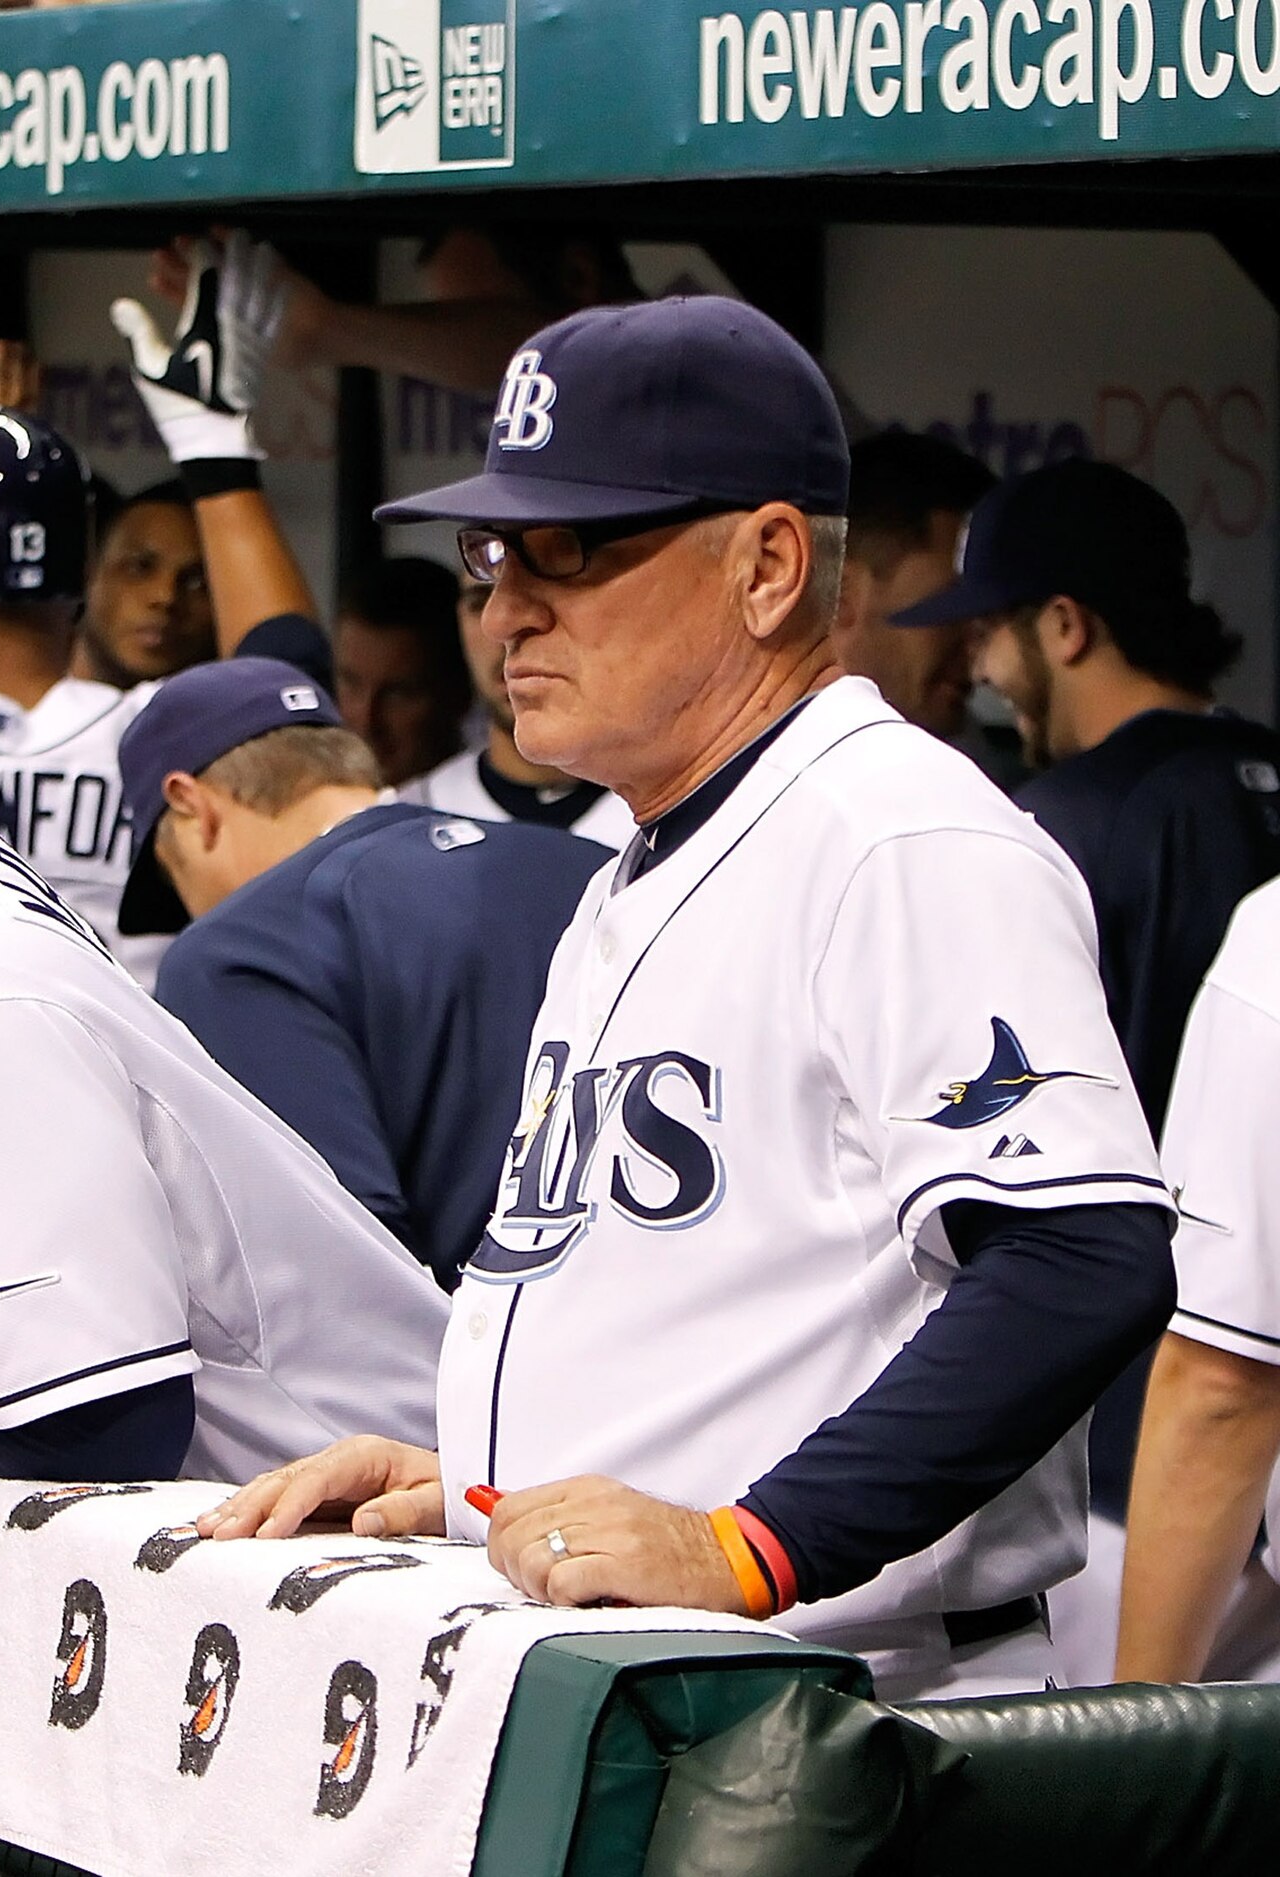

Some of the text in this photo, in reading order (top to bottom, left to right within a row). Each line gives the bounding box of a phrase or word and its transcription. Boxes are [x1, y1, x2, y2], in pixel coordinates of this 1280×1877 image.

[443, 23, 505, 77] NEW
[443, 75, 503, 129] ERA
[10, 521, 46, 562] 13
